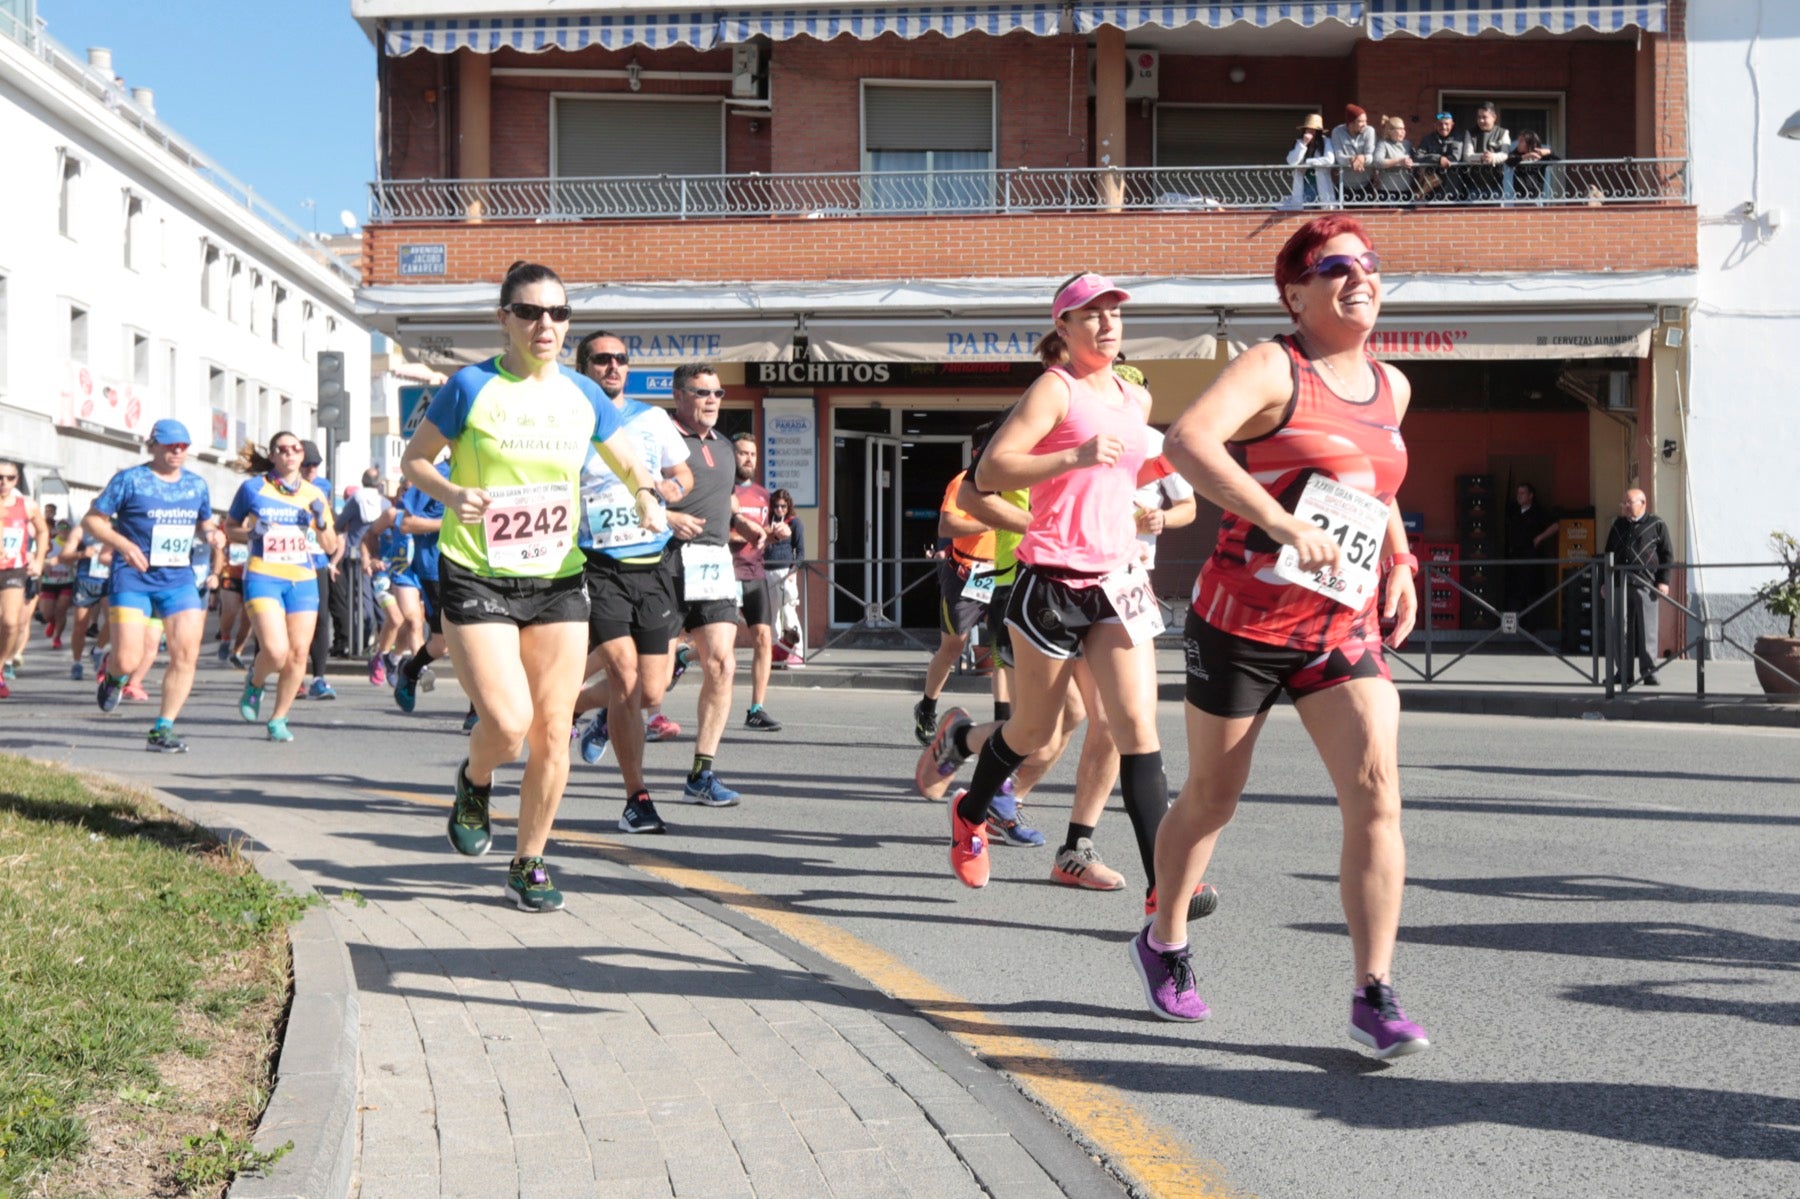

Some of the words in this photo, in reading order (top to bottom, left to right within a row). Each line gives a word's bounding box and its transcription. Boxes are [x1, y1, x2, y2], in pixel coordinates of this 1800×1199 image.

[411, 246, 443, 254] AVENIDA
[402, 263, 444, 273] CAMARERO
[945, 332, 1042, 355] PARAD
[1552, 335, 1592, 345] CERVEZAS
[759, 363, 891, 383] BICHITOS
[491, 505, 568, 541] 2242
[268, 537, 306, 552] 2118
[700, 563, 720, 581] 73
